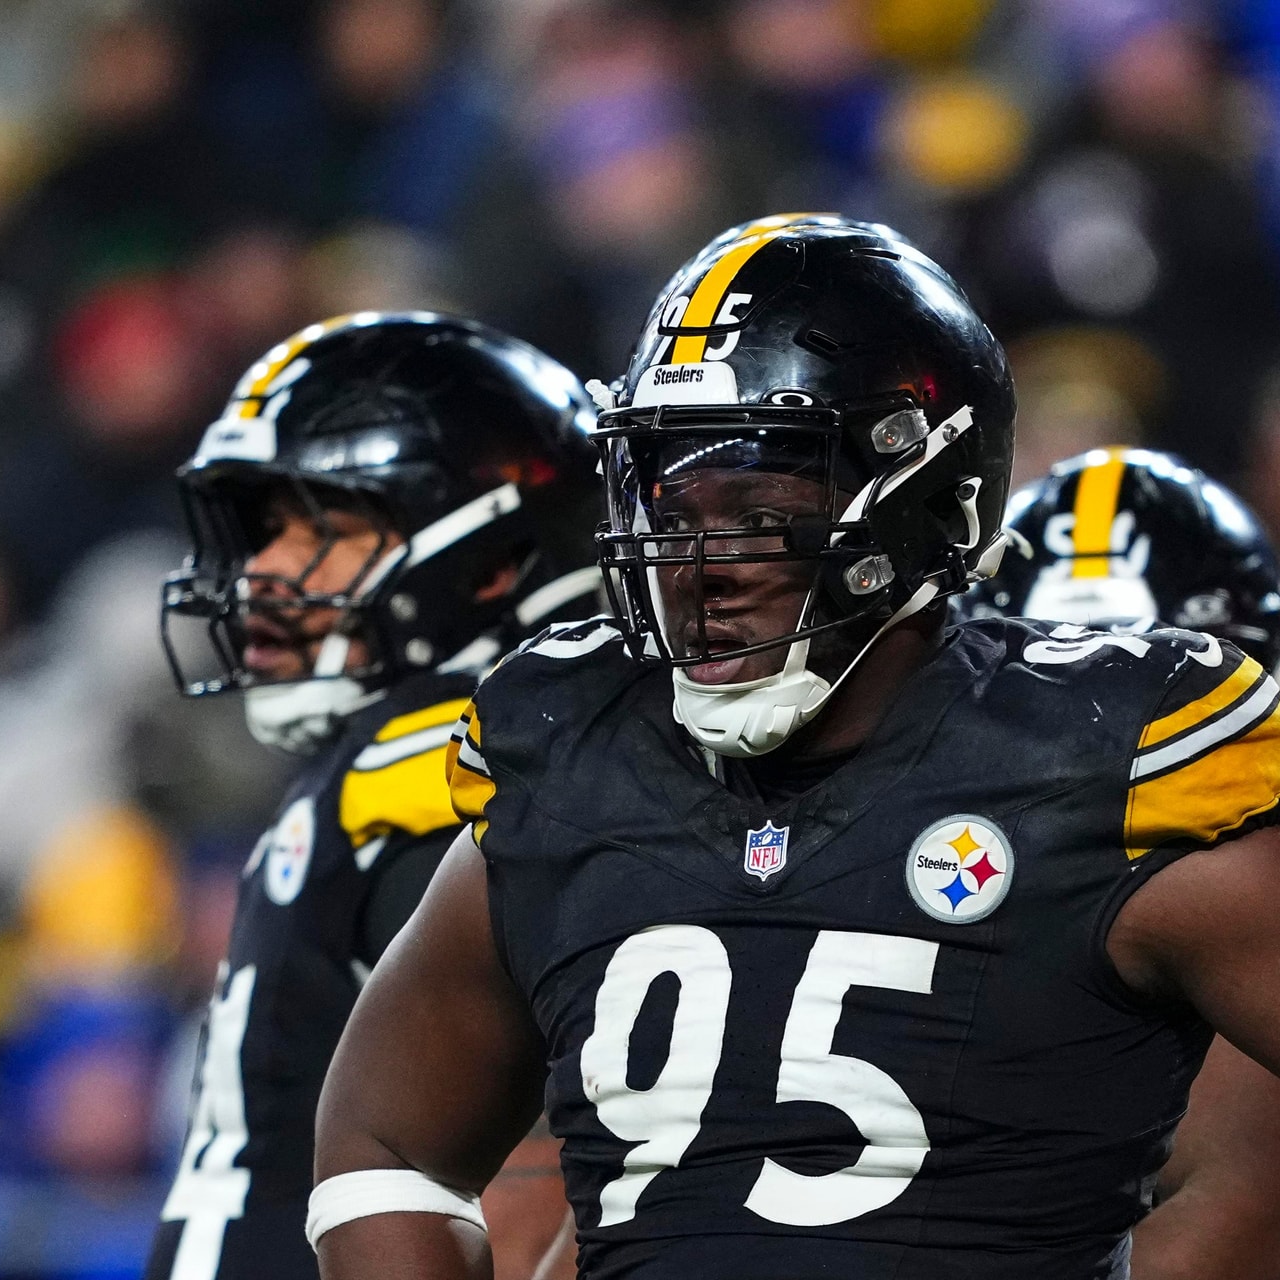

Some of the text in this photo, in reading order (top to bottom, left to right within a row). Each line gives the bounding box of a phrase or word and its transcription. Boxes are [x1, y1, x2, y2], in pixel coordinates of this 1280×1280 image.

[654, 365, 704, 386] Steelers
[751, 847, 779, 869] NFL
[917, 855, 958, 871] Steelers
[580, 924, 940, 1227] 95
